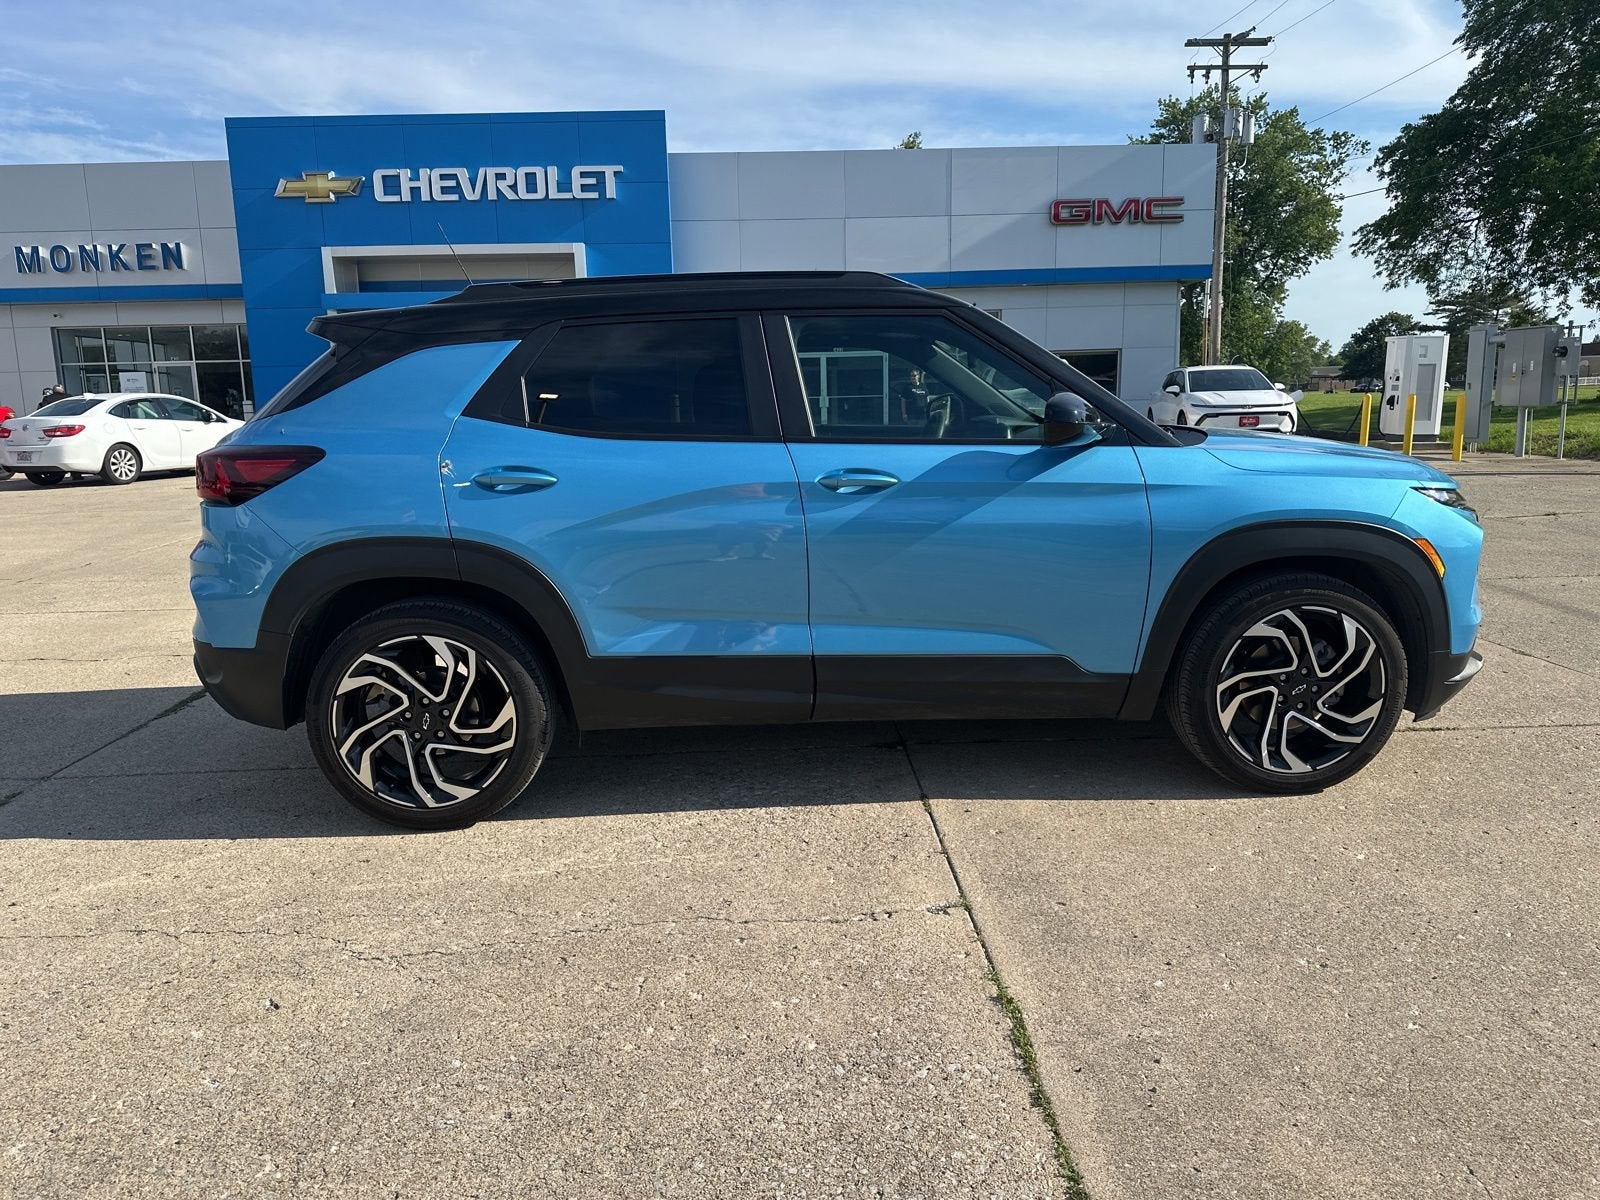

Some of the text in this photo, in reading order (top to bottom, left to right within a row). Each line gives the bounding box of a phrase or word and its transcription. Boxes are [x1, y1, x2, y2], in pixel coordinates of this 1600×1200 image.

[373, 165, 624, 202] CHEVROLET
[1050, 197, 1184, 225] GMC
[14, 242, 187, 273] MONKEN
